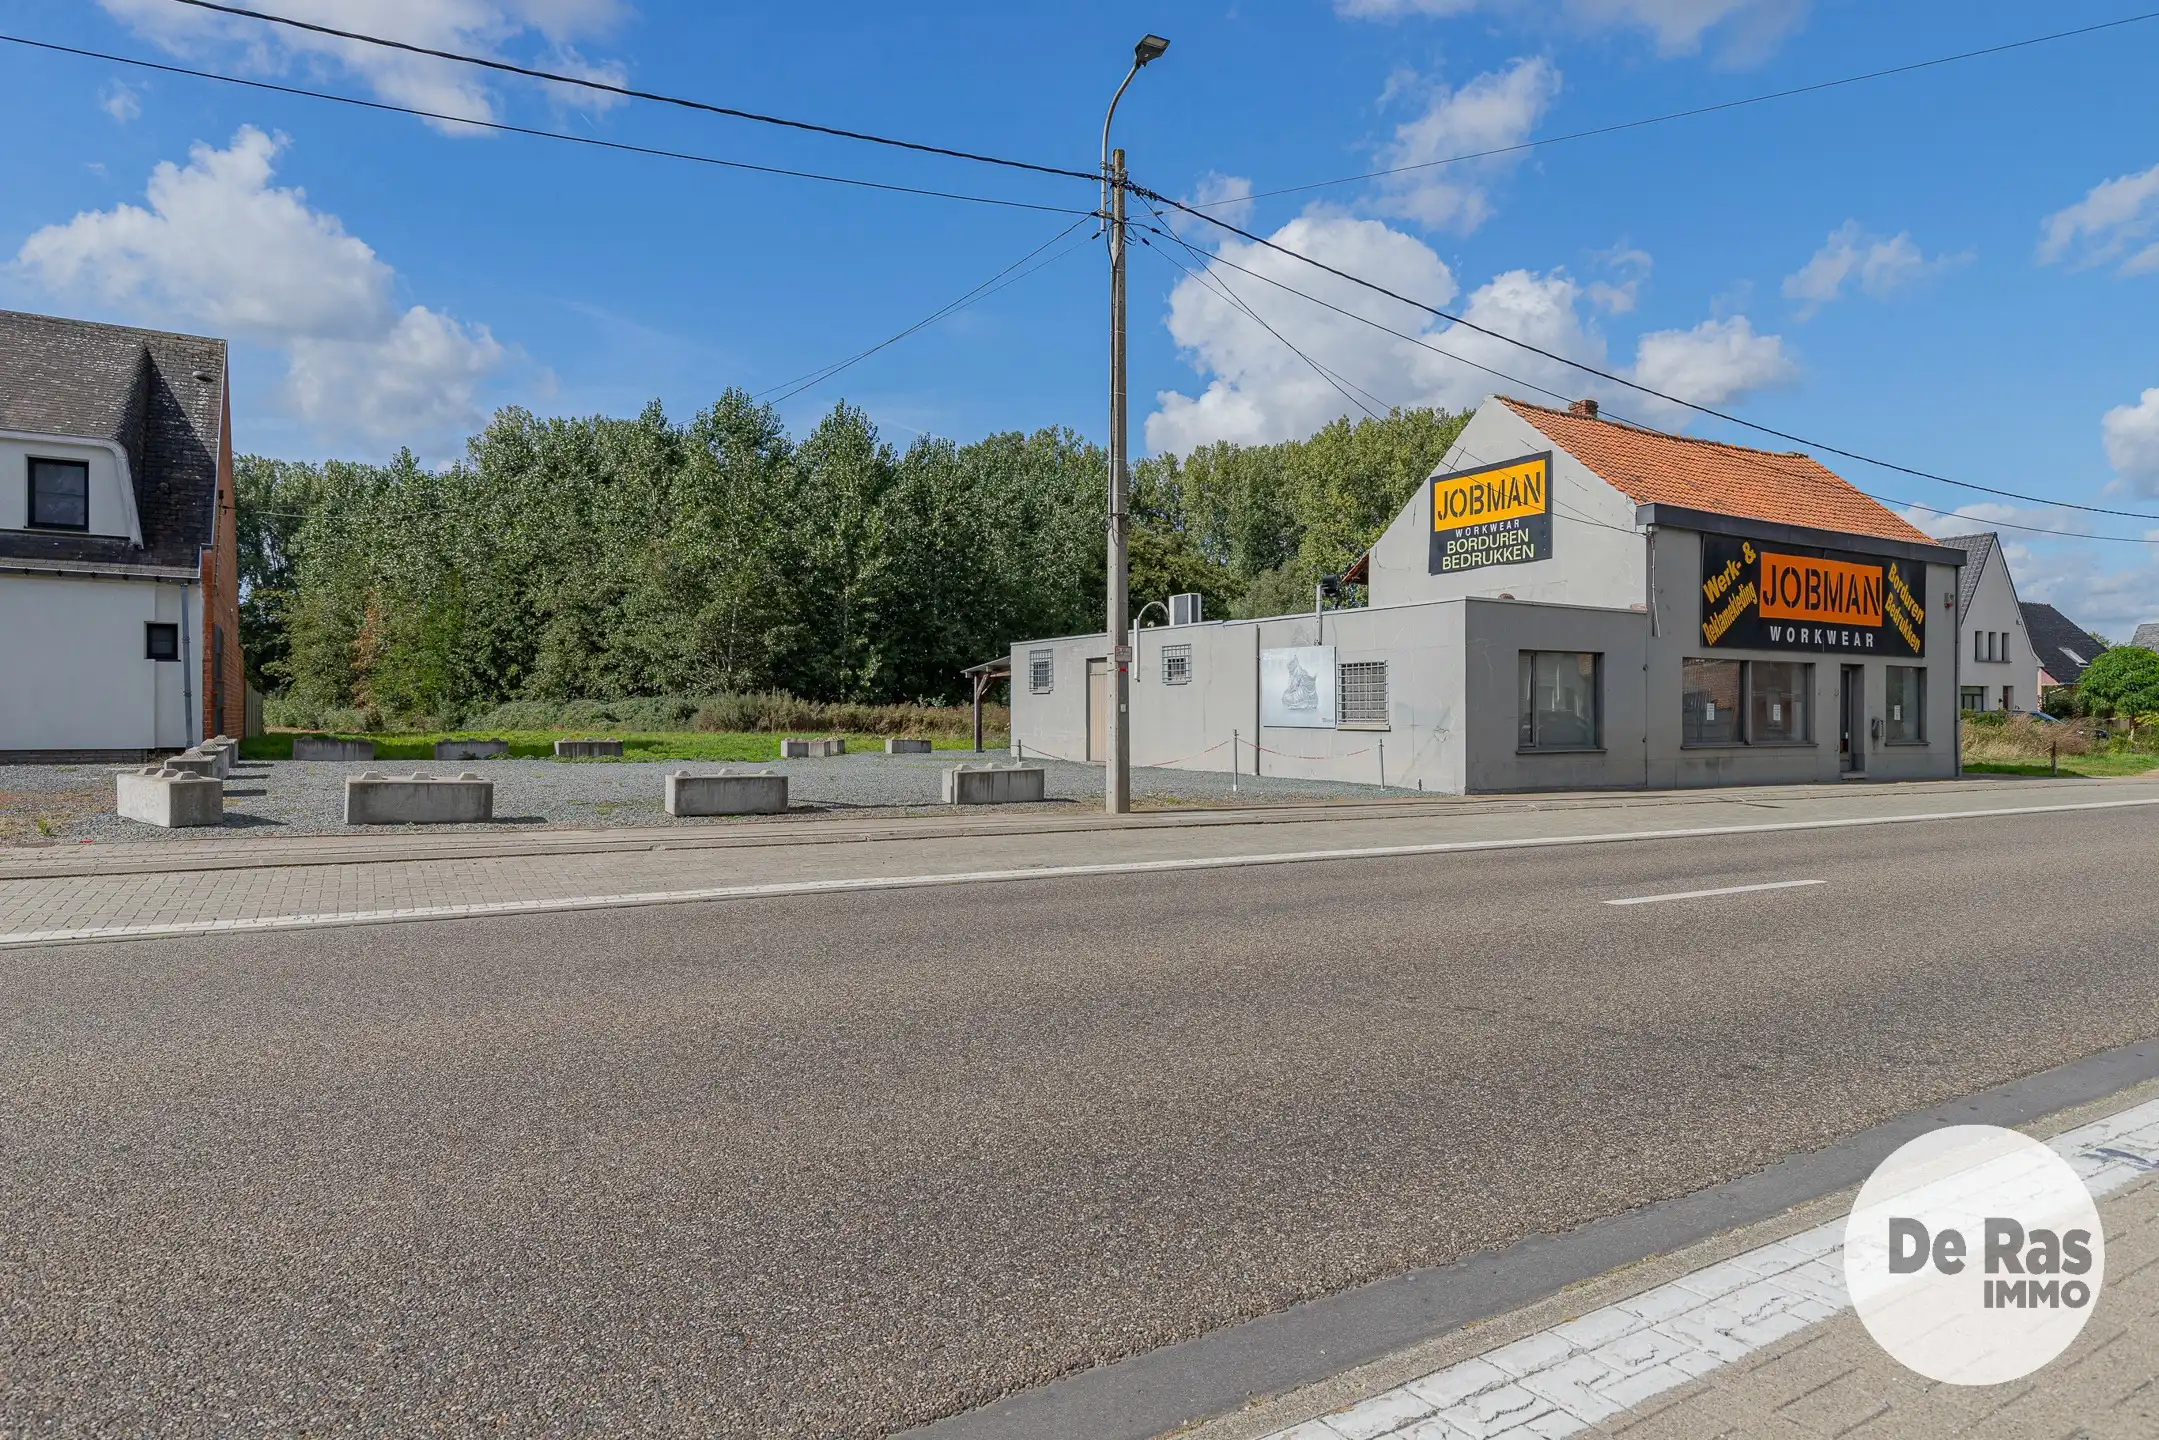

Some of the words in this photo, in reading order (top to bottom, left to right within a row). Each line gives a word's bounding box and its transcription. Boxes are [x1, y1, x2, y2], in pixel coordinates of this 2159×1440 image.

[1437, 471, 1541, 521] JOBMAN
[1447, 528, 1529, 554] BORDUREN
[1455, 519, 1521, 538] WORKWEAR
[1442, 543, 1535, 571] BEDRUKKEN
[1703, 559, 1742, 604] Werk-
[1741, 541, 1757, 564] &
[1702, 580, 1758, 646] Reklamekleding
[1762, 564, 1881, 617] JOBMAN
[1887, 562, 1925, 625] Borduren
[1770, 625, 1874, 648] WORKWEAR
[1884, 592, 1921, 654] Bedrukken
